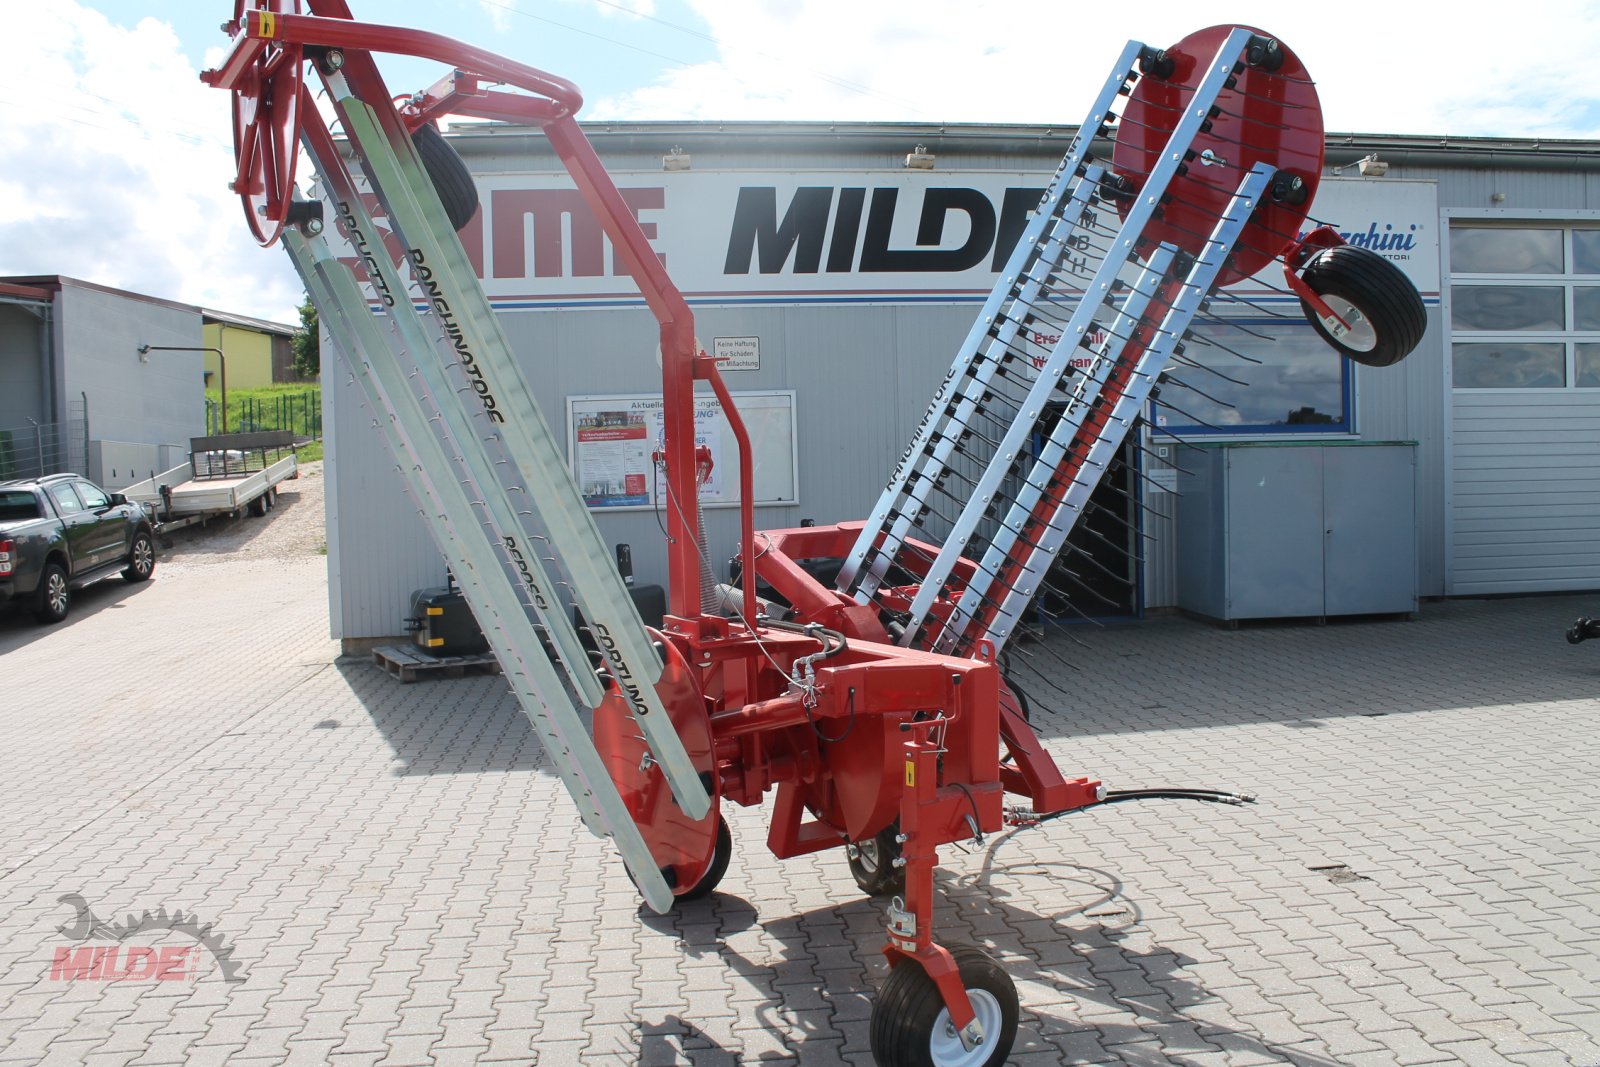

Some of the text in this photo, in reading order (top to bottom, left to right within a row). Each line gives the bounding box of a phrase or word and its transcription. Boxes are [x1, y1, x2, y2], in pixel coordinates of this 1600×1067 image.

[408, 248, 505, 424] RANGHINATORE
[734, 340, 757, 348] Haftung
[592, 621, 649, 716] FORTUNA
